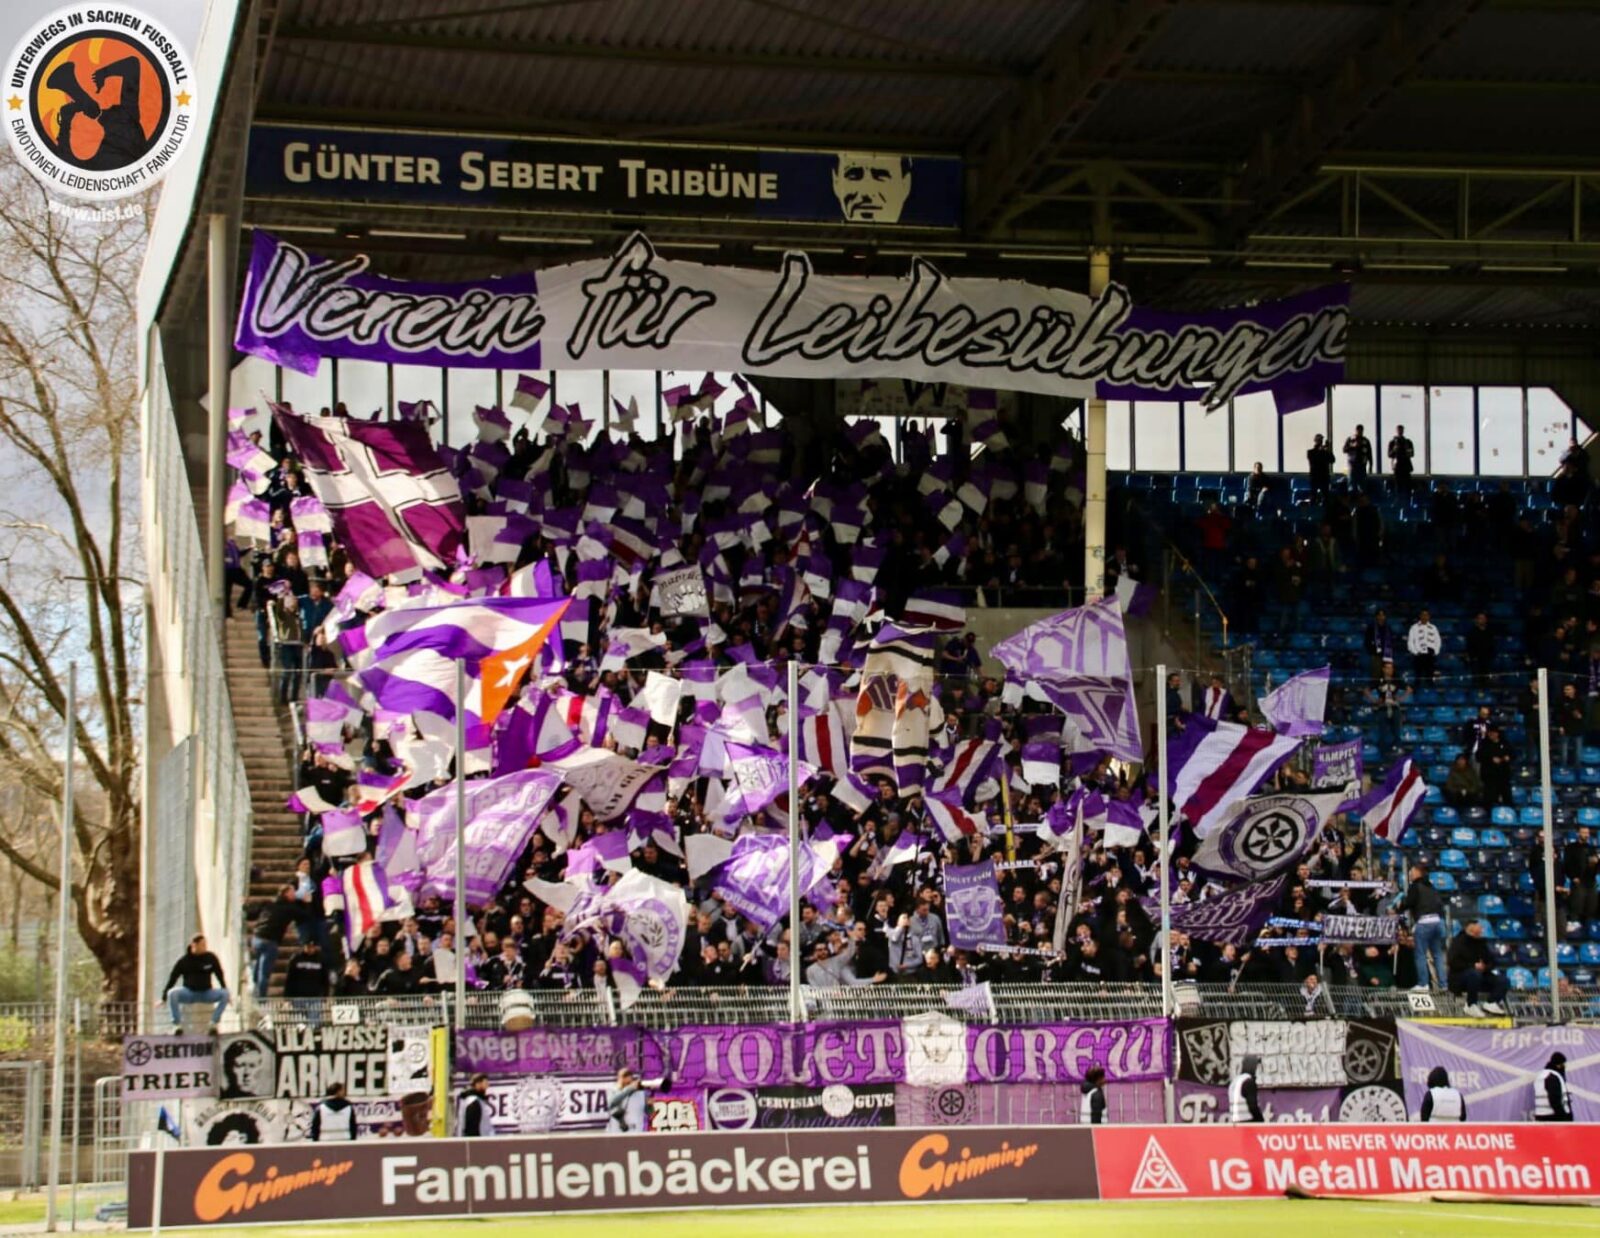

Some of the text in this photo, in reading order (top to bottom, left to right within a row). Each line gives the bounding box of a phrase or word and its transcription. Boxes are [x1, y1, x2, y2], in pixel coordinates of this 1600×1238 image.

[283, 141, 779, 200] GÜNTER SEBERT TRIBÜNE
[250, 229, 1350, 416] Verein für Leibesübungen
[336, 1008, 356, 1021] 27
[1411, 995, 1431, 1009] 26
[153, 1041, 214, 1060] SEKTION
[276, 1025, 387, 1051] LILA-WEISSE
[1491, 1029, 1585, 1050] FAN-CLUB
[653, 1023, 1168, 1087] VIOLET CREW
[124, 1070, 211, 1092] TRIER
[276, 1053, 386, 1098] ARMEE
[854, 1092, 894, 1109] GUYS
[1327, 1134, 1386, 1151] NEVER
[1391, 1134, 1450, 1151] WORK
[1454, 1134, 1516, 1151] ALONE
[381, 1146, 871, 1205] Familienbäckerei
[899, 1133, 1039, 1198] Grimminger
[1209, 1156, 1590, 1190] IG Metall Mannheim
[193, 1153, 353, 1222] Grimminger
